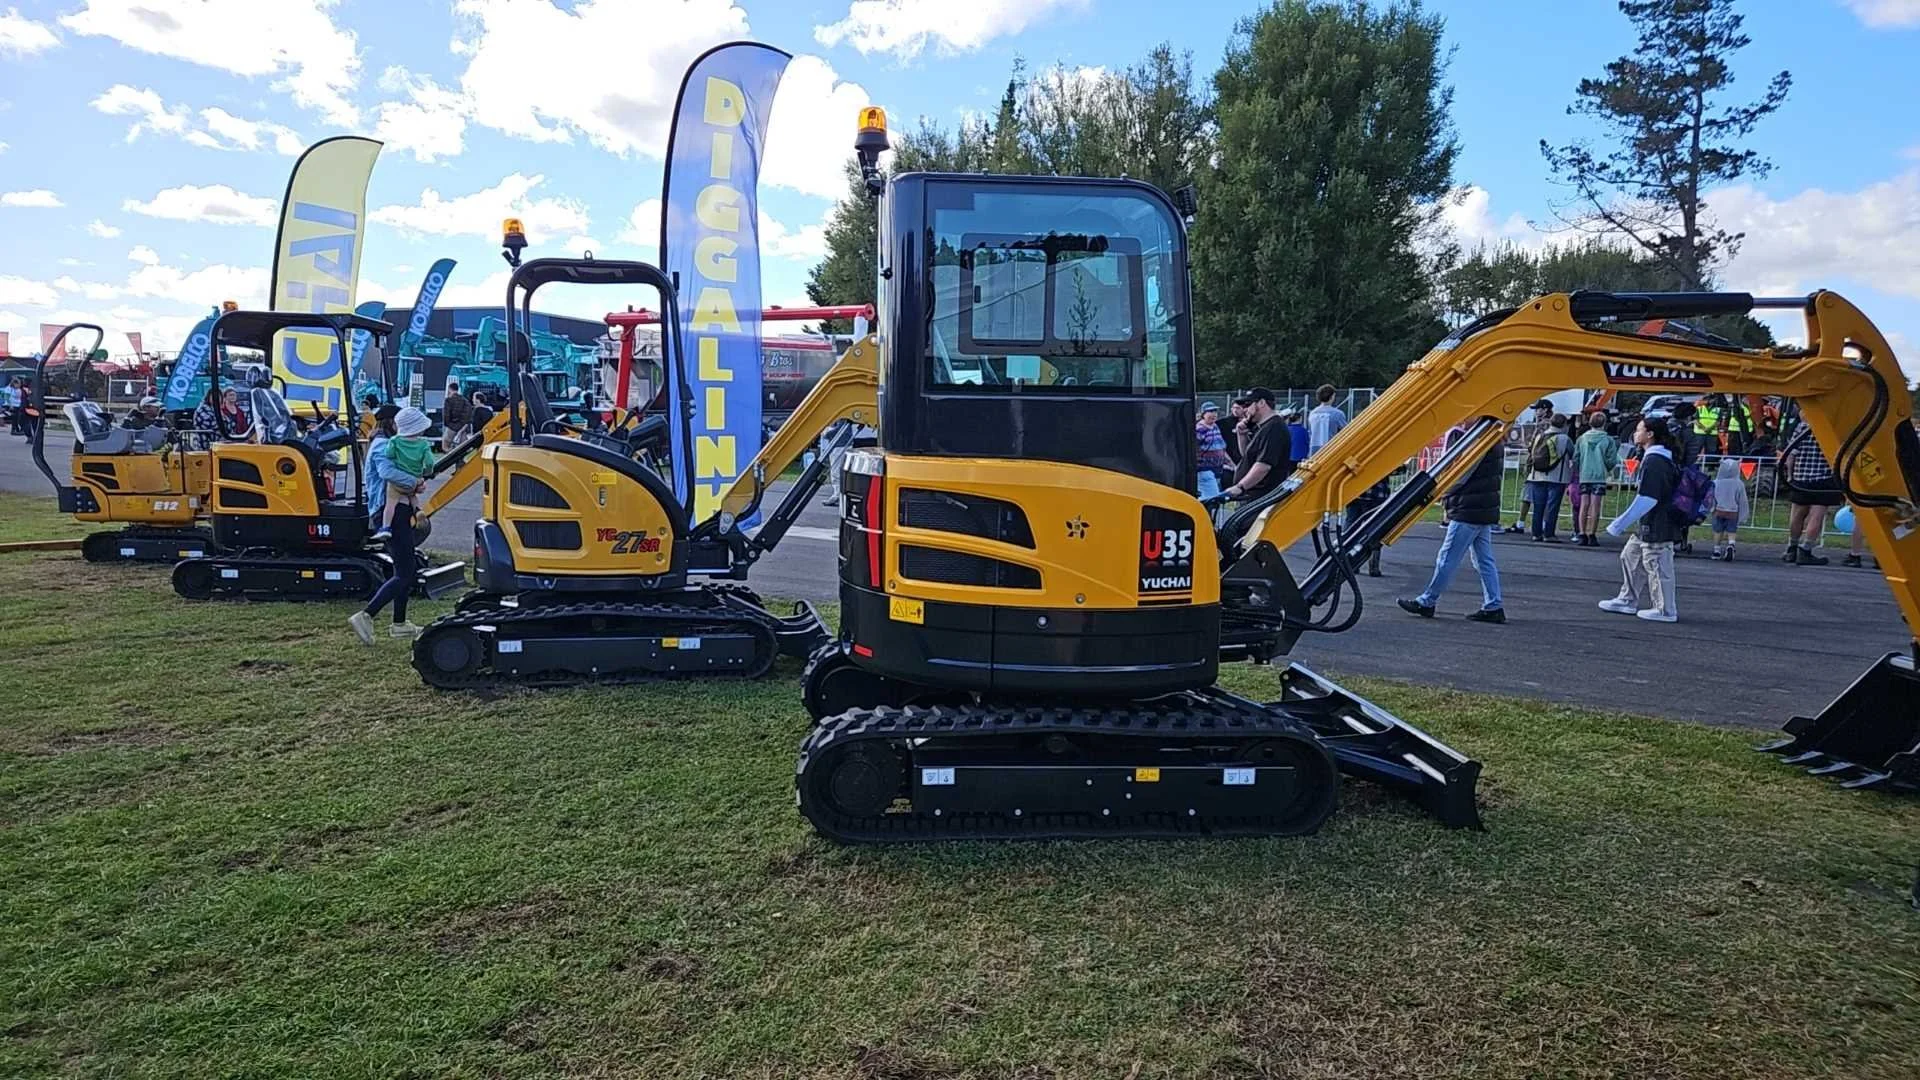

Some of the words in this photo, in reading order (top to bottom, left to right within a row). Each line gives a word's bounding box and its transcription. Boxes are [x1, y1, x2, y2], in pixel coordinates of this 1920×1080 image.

[409, 271, 444, 337] KOBELCO
[167, 333, 210, 402] KOBELCO
[1607, 360, 1697, 380] YUCHAI
[154, 501, 179, 511] E12
[308, 523, 331, 536] U18
[1143, 529, 1192, 559] U35
[1141, 575, 1191, 589] YUCHAI
